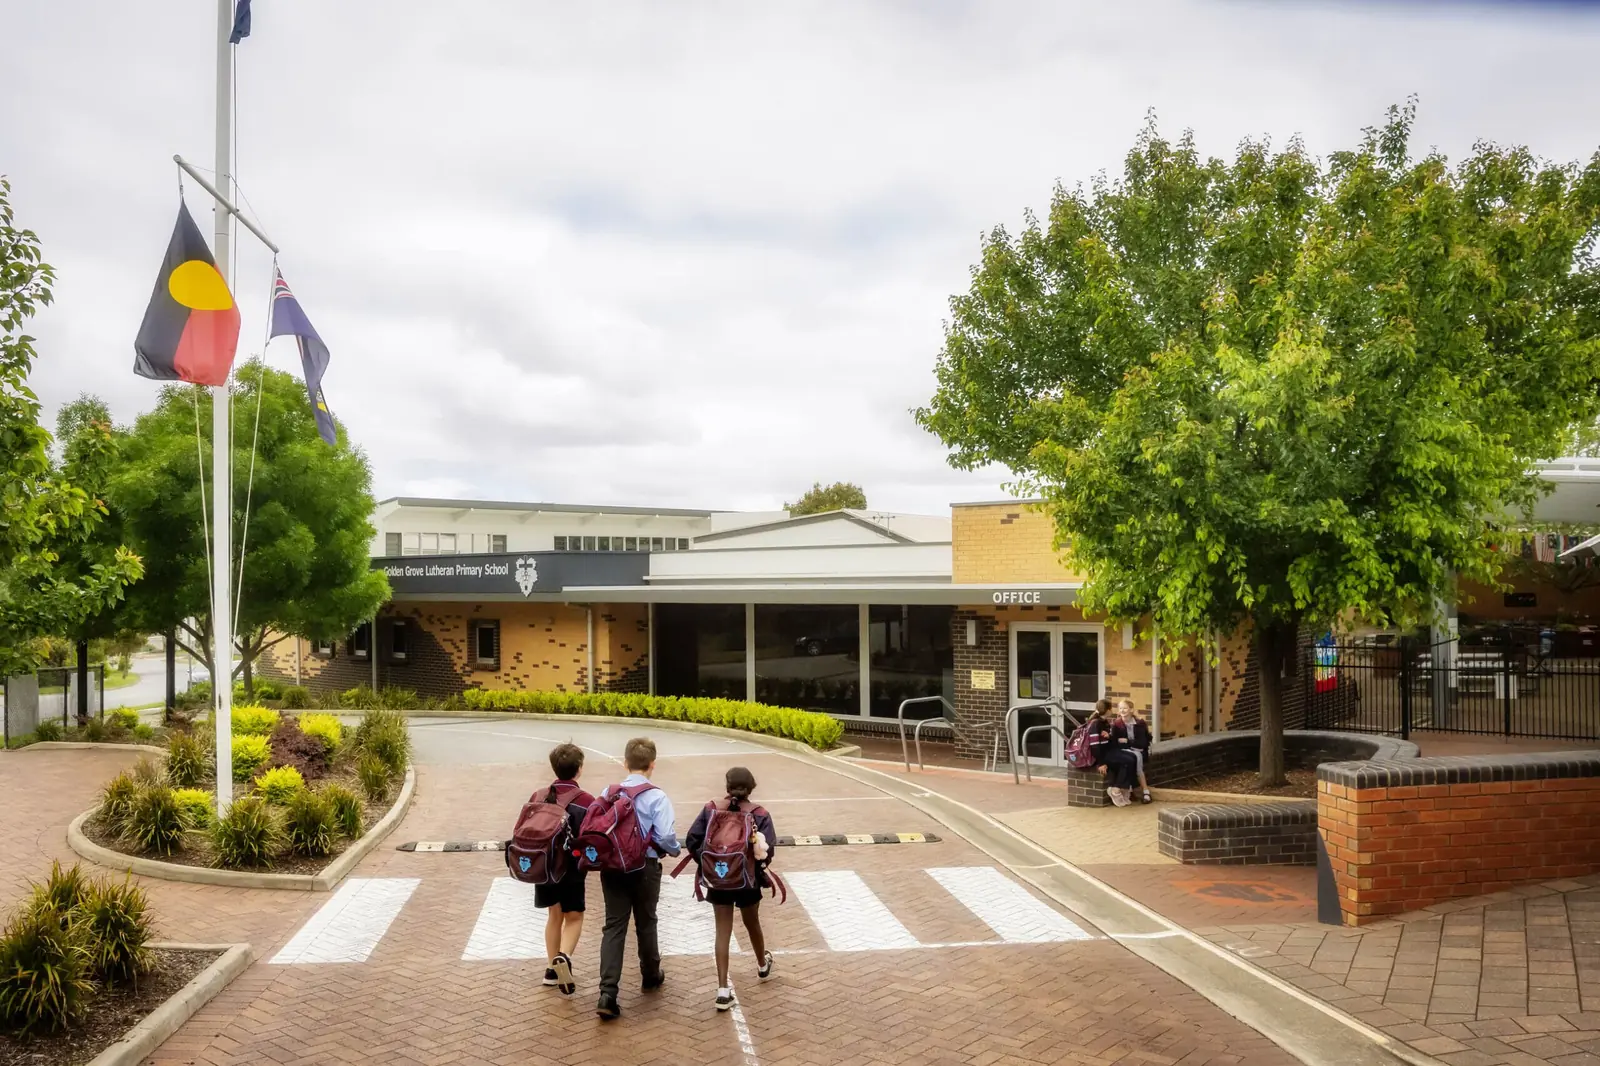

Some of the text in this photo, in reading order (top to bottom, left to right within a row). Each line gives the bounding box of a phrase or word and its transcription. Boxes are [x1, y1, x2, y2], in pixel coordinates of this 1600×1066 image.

[384, 563, 509, 578] Golden Grove Lutheran Primary School
[992, 591, 1041, 604] OFFICE
